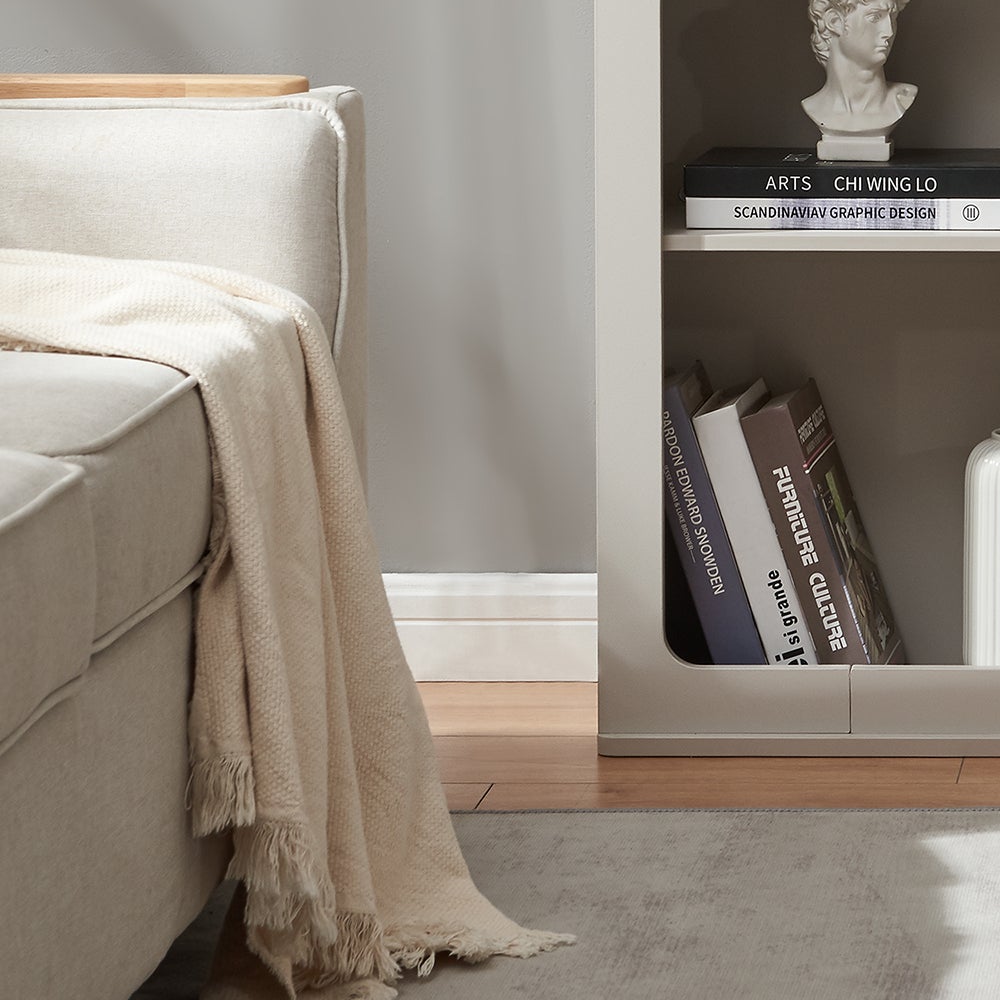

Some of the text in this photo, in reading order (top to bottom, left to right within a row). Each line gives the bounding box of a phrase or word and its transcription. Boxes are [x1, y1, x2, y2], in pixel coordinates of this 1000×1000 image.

[734, 206, 936, 219] SCANDINAVIAV GRAPHIC DESIGN
[765, 175, 938, 192] ARTS CHI WING LO
[676, 467, 703, 526] EDWARD
[694, 526, 725, 597] SNOWDEN
[772, 465, 819, 567] FURNITURE
[809, 572, 848, 652] CULTURE
[767, 569, 798, 627] grande
